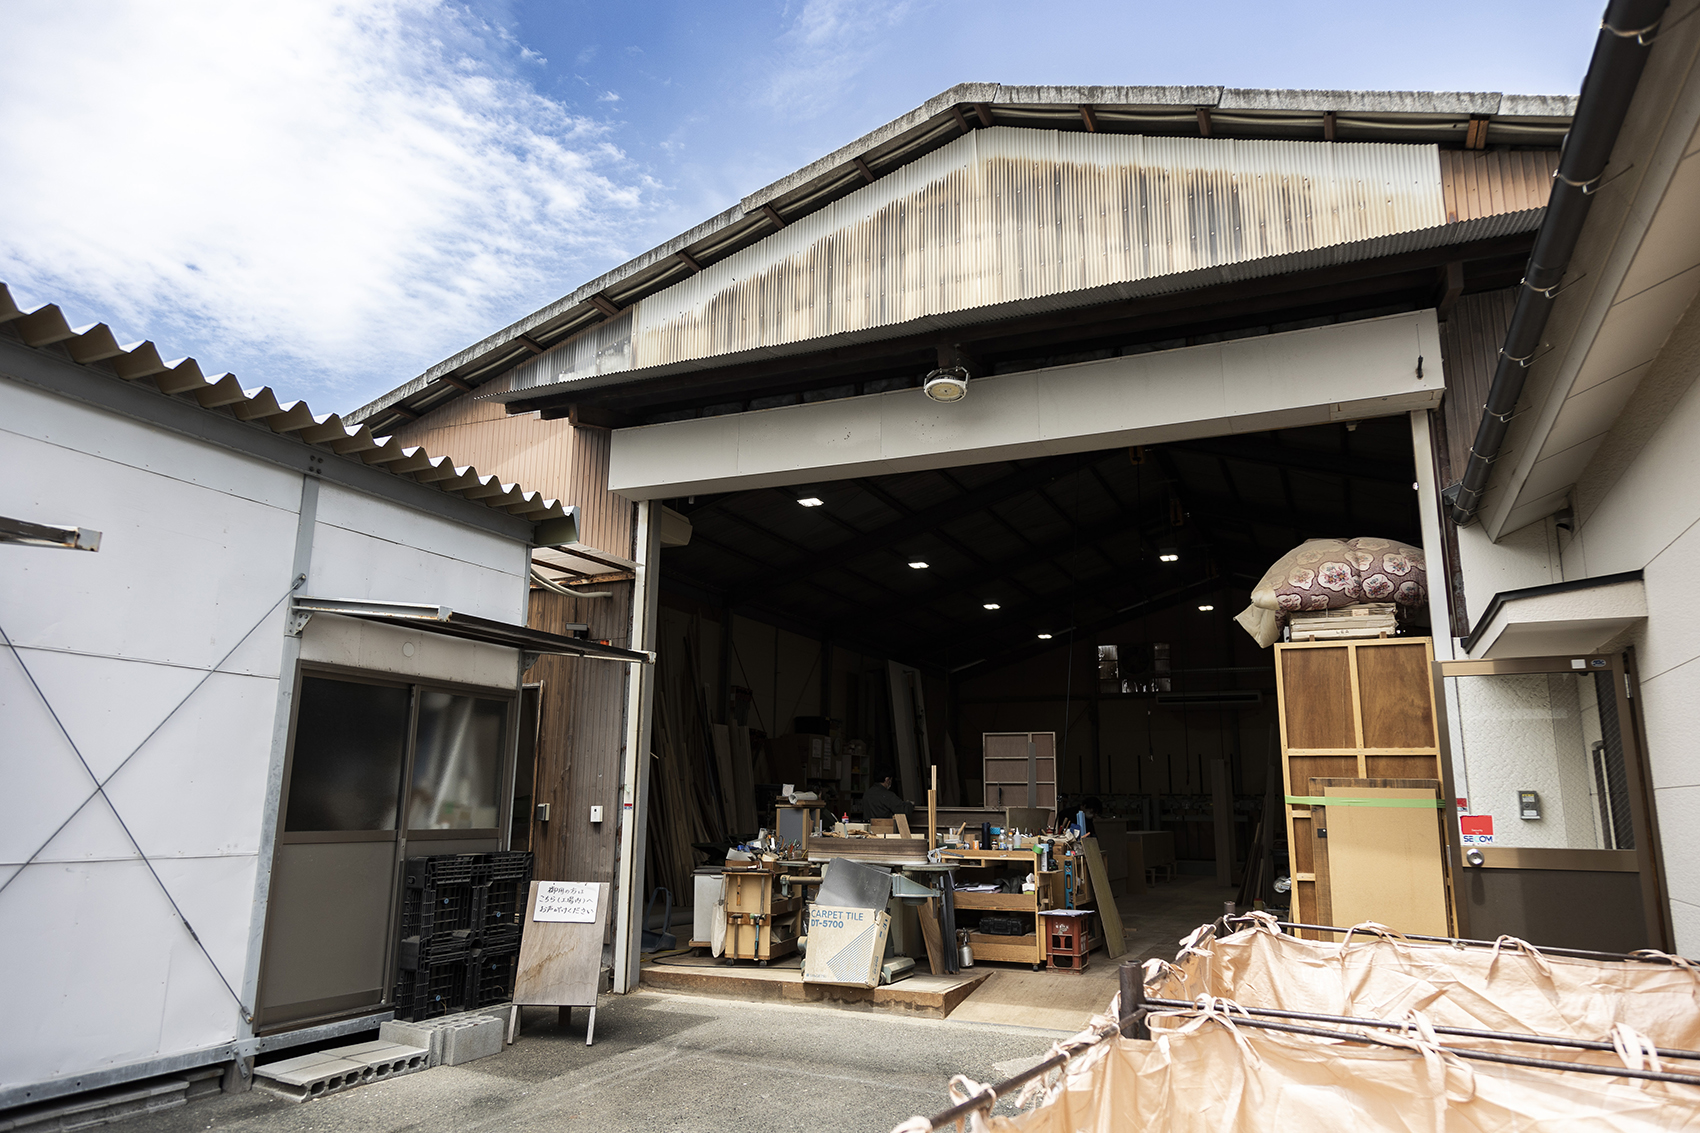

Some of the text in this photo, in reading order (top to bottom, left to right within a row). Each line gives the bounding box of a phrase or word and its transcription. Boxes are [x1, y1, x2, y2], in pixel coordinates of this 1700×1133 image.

[1463, 835, 1493, 843] SECOM
[811, 909, 864, 921] CARPET TILE
[811, 919, 844, 928] DT-5700
